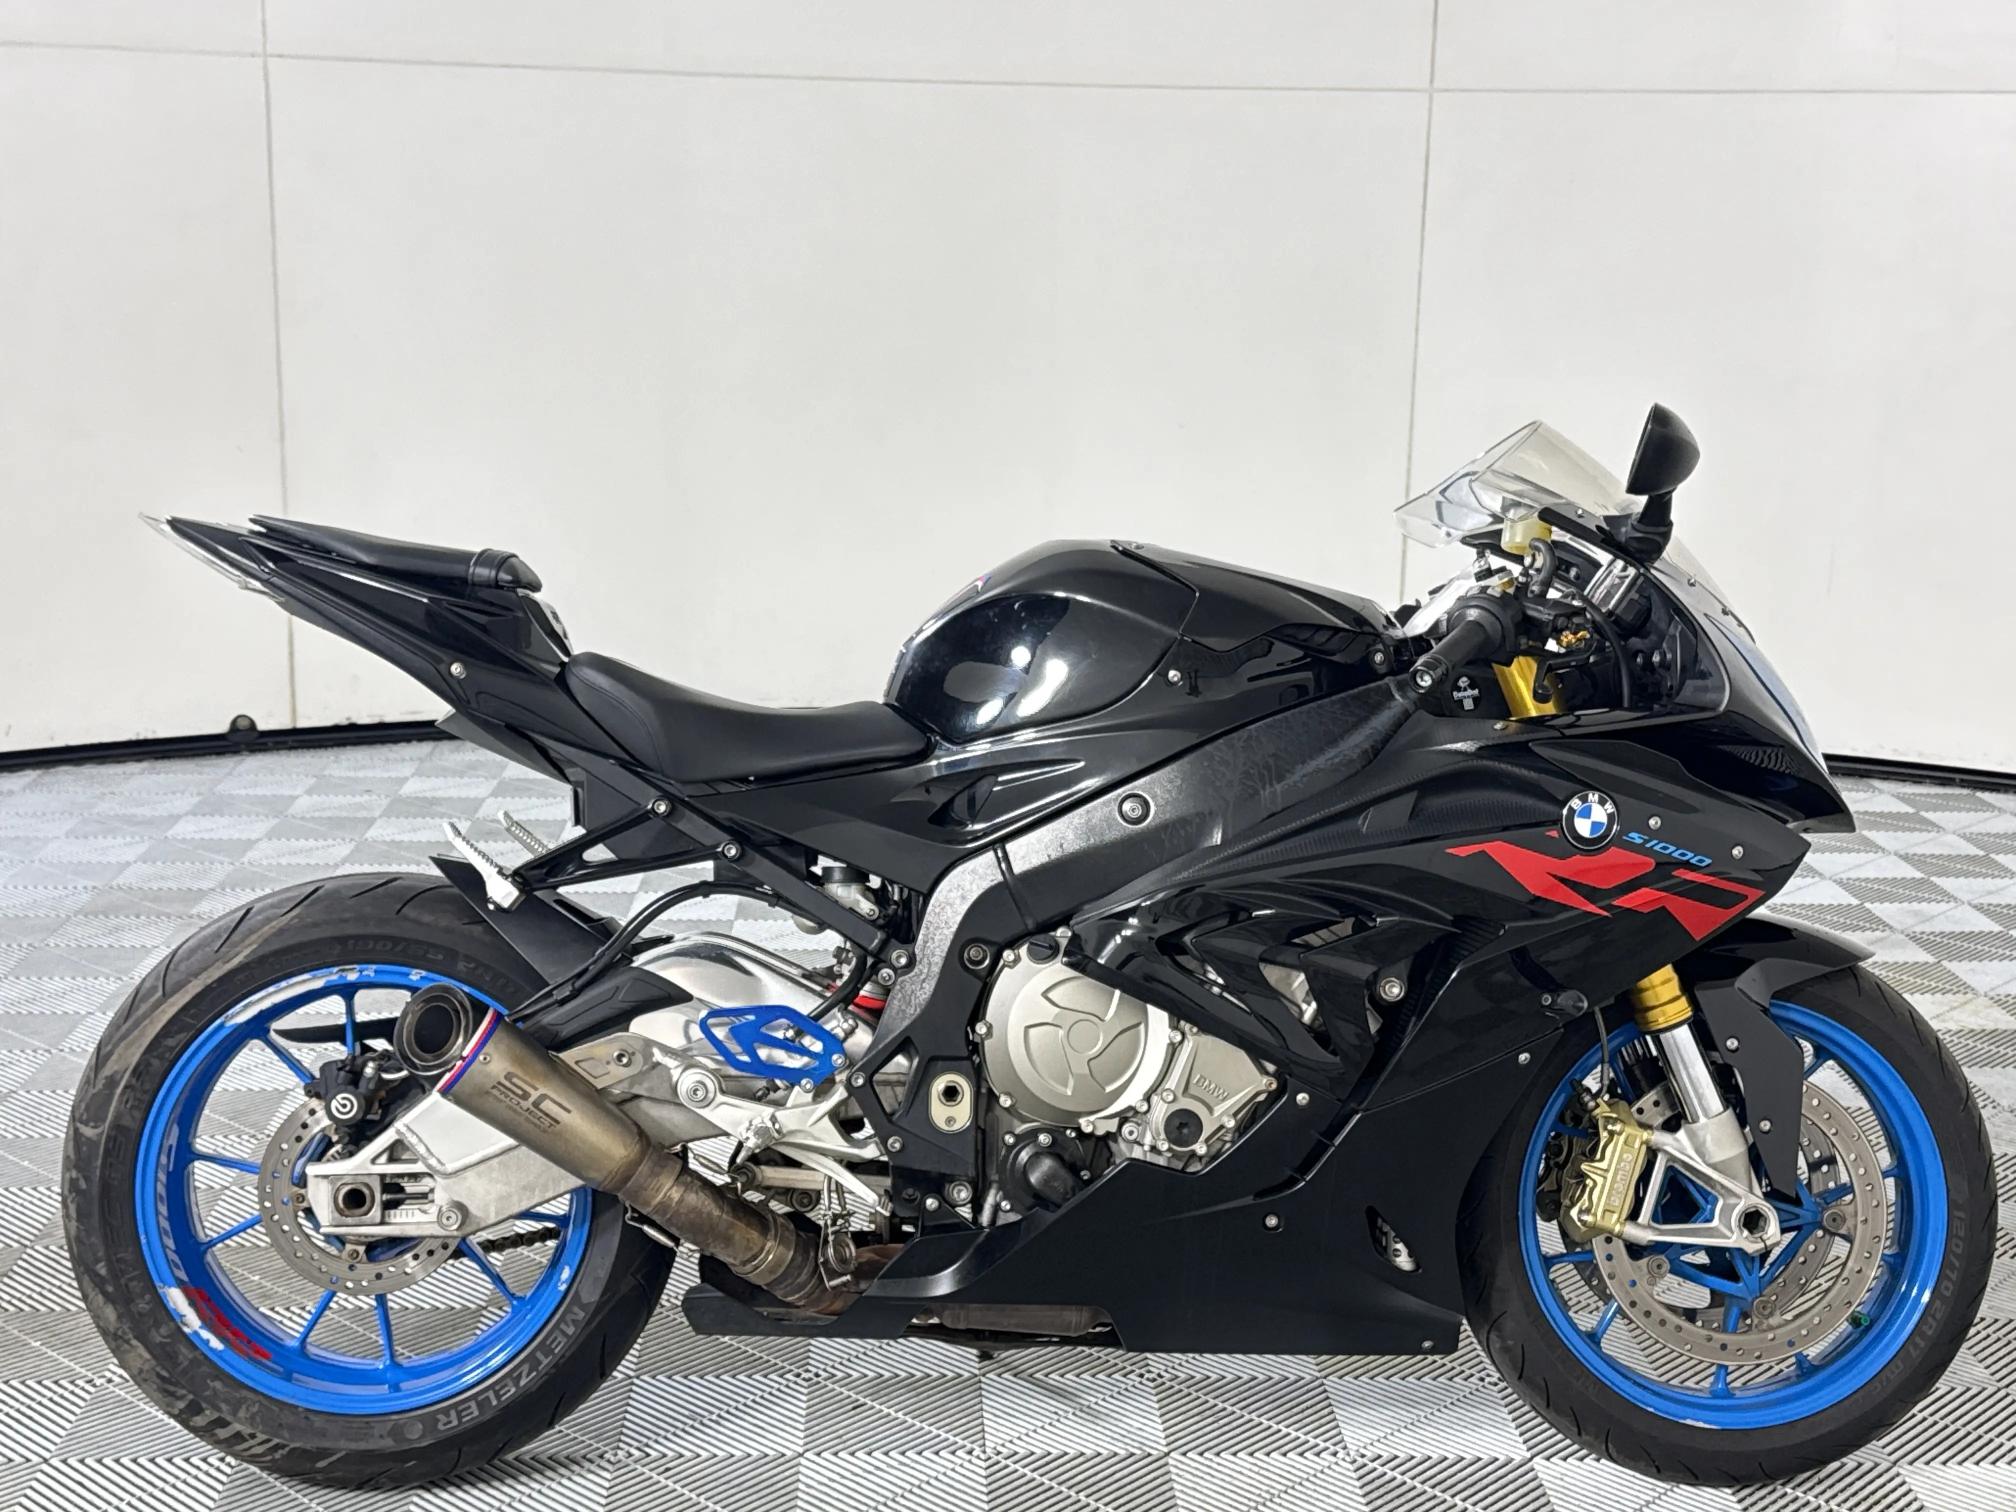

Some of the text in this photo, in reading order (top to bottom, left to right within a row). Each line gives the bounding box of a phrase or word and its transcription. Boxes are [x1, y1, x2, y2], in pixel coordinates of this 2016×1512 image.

[1570, 793, 1615, 814] BMW
[1622, 831, 1713, 868] S1000
[490, 1085, 557, 1129] PROJECT
[496, 1071, 572, 1125] SC
[1192, 1074, 1230, 1101] BMW
[1607, 1152, 1633, 1206] brembo
[436, 1305, 586, 1431] METZELER
